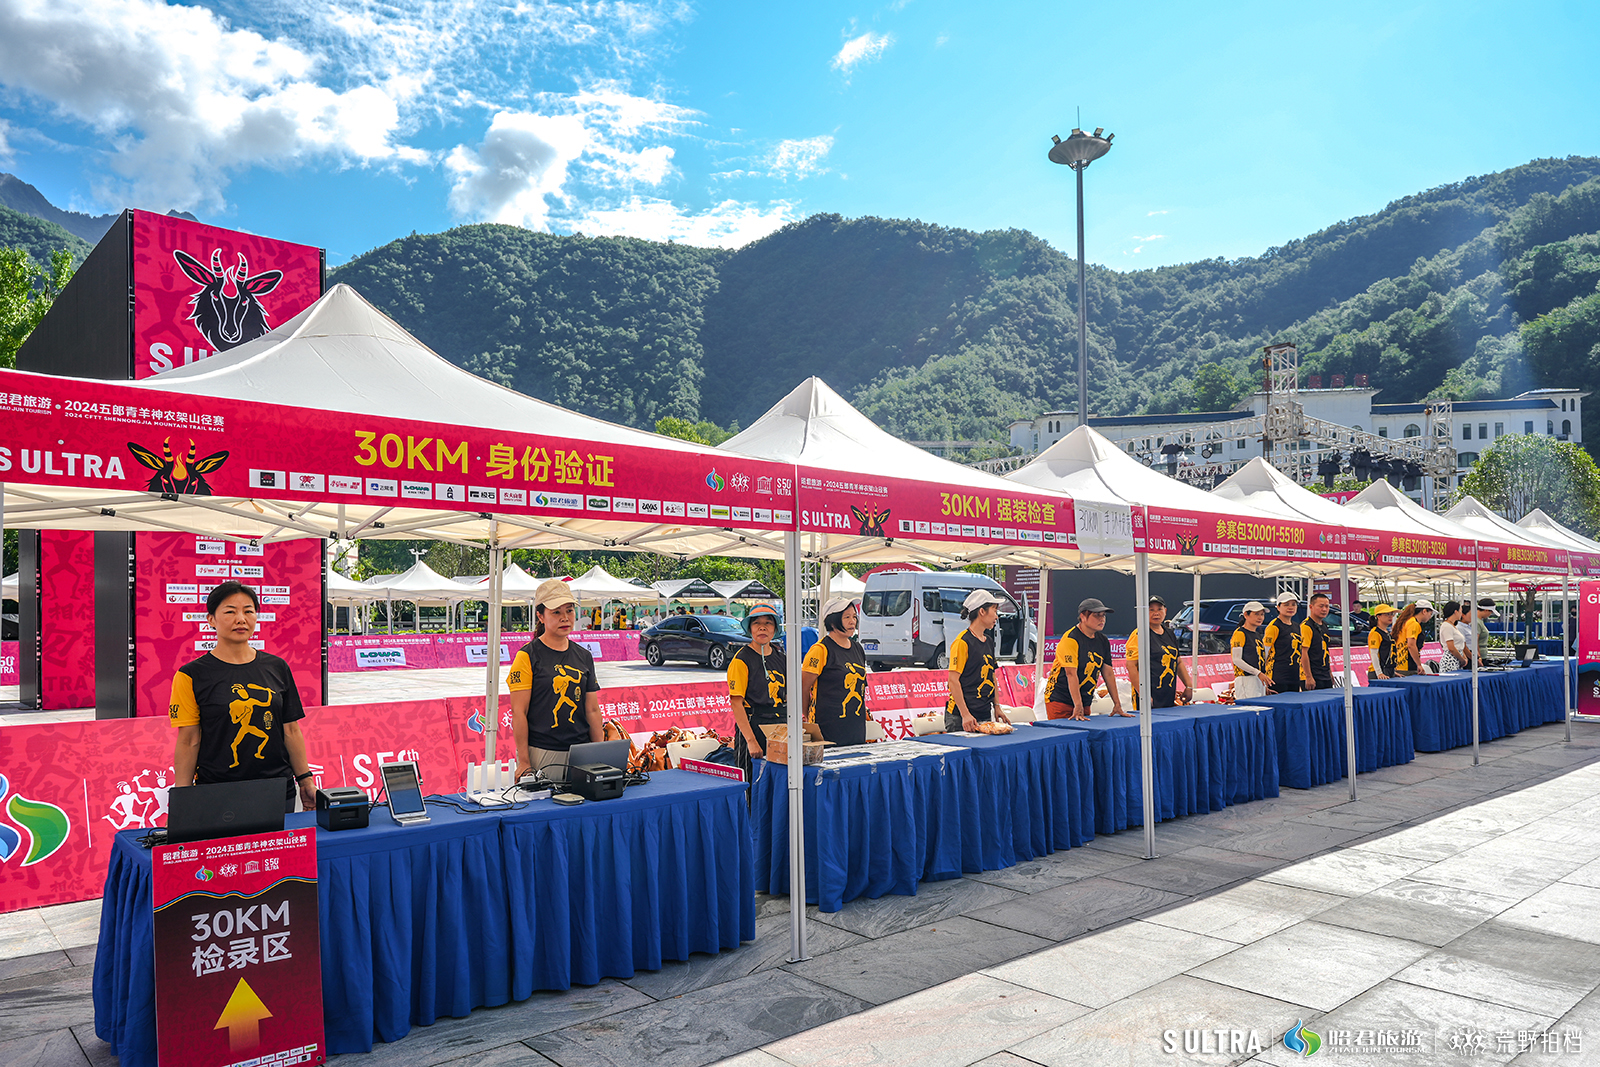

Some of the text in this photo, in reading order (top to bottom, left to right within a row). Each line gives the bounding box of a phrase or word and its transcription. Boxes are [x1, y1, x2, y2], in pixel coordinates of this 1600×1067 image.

[64, 400, 224, 427] 2024五郎青羊神农架山径赛
[21, 448, 126, 480] ULTRA
[354, 430, 614, 487] 30KM 身份验证
[802, 510, 851, 528] S ULTRA
[940, 492, 1056, 525] 30KM 强装检查
[1150, 538, 1176, 550] S ULTRA
[1216, 518, 1305, 544] 参赛包30001-55180
[874, 684, 906, 696] 昭君旅游
[162, 835, 308, 861] 昭君旅游 2024五郎青羊神农架山径赛
[190, 900, 290, 942] 30KM
[192, 930, 292, 978] 检录区
